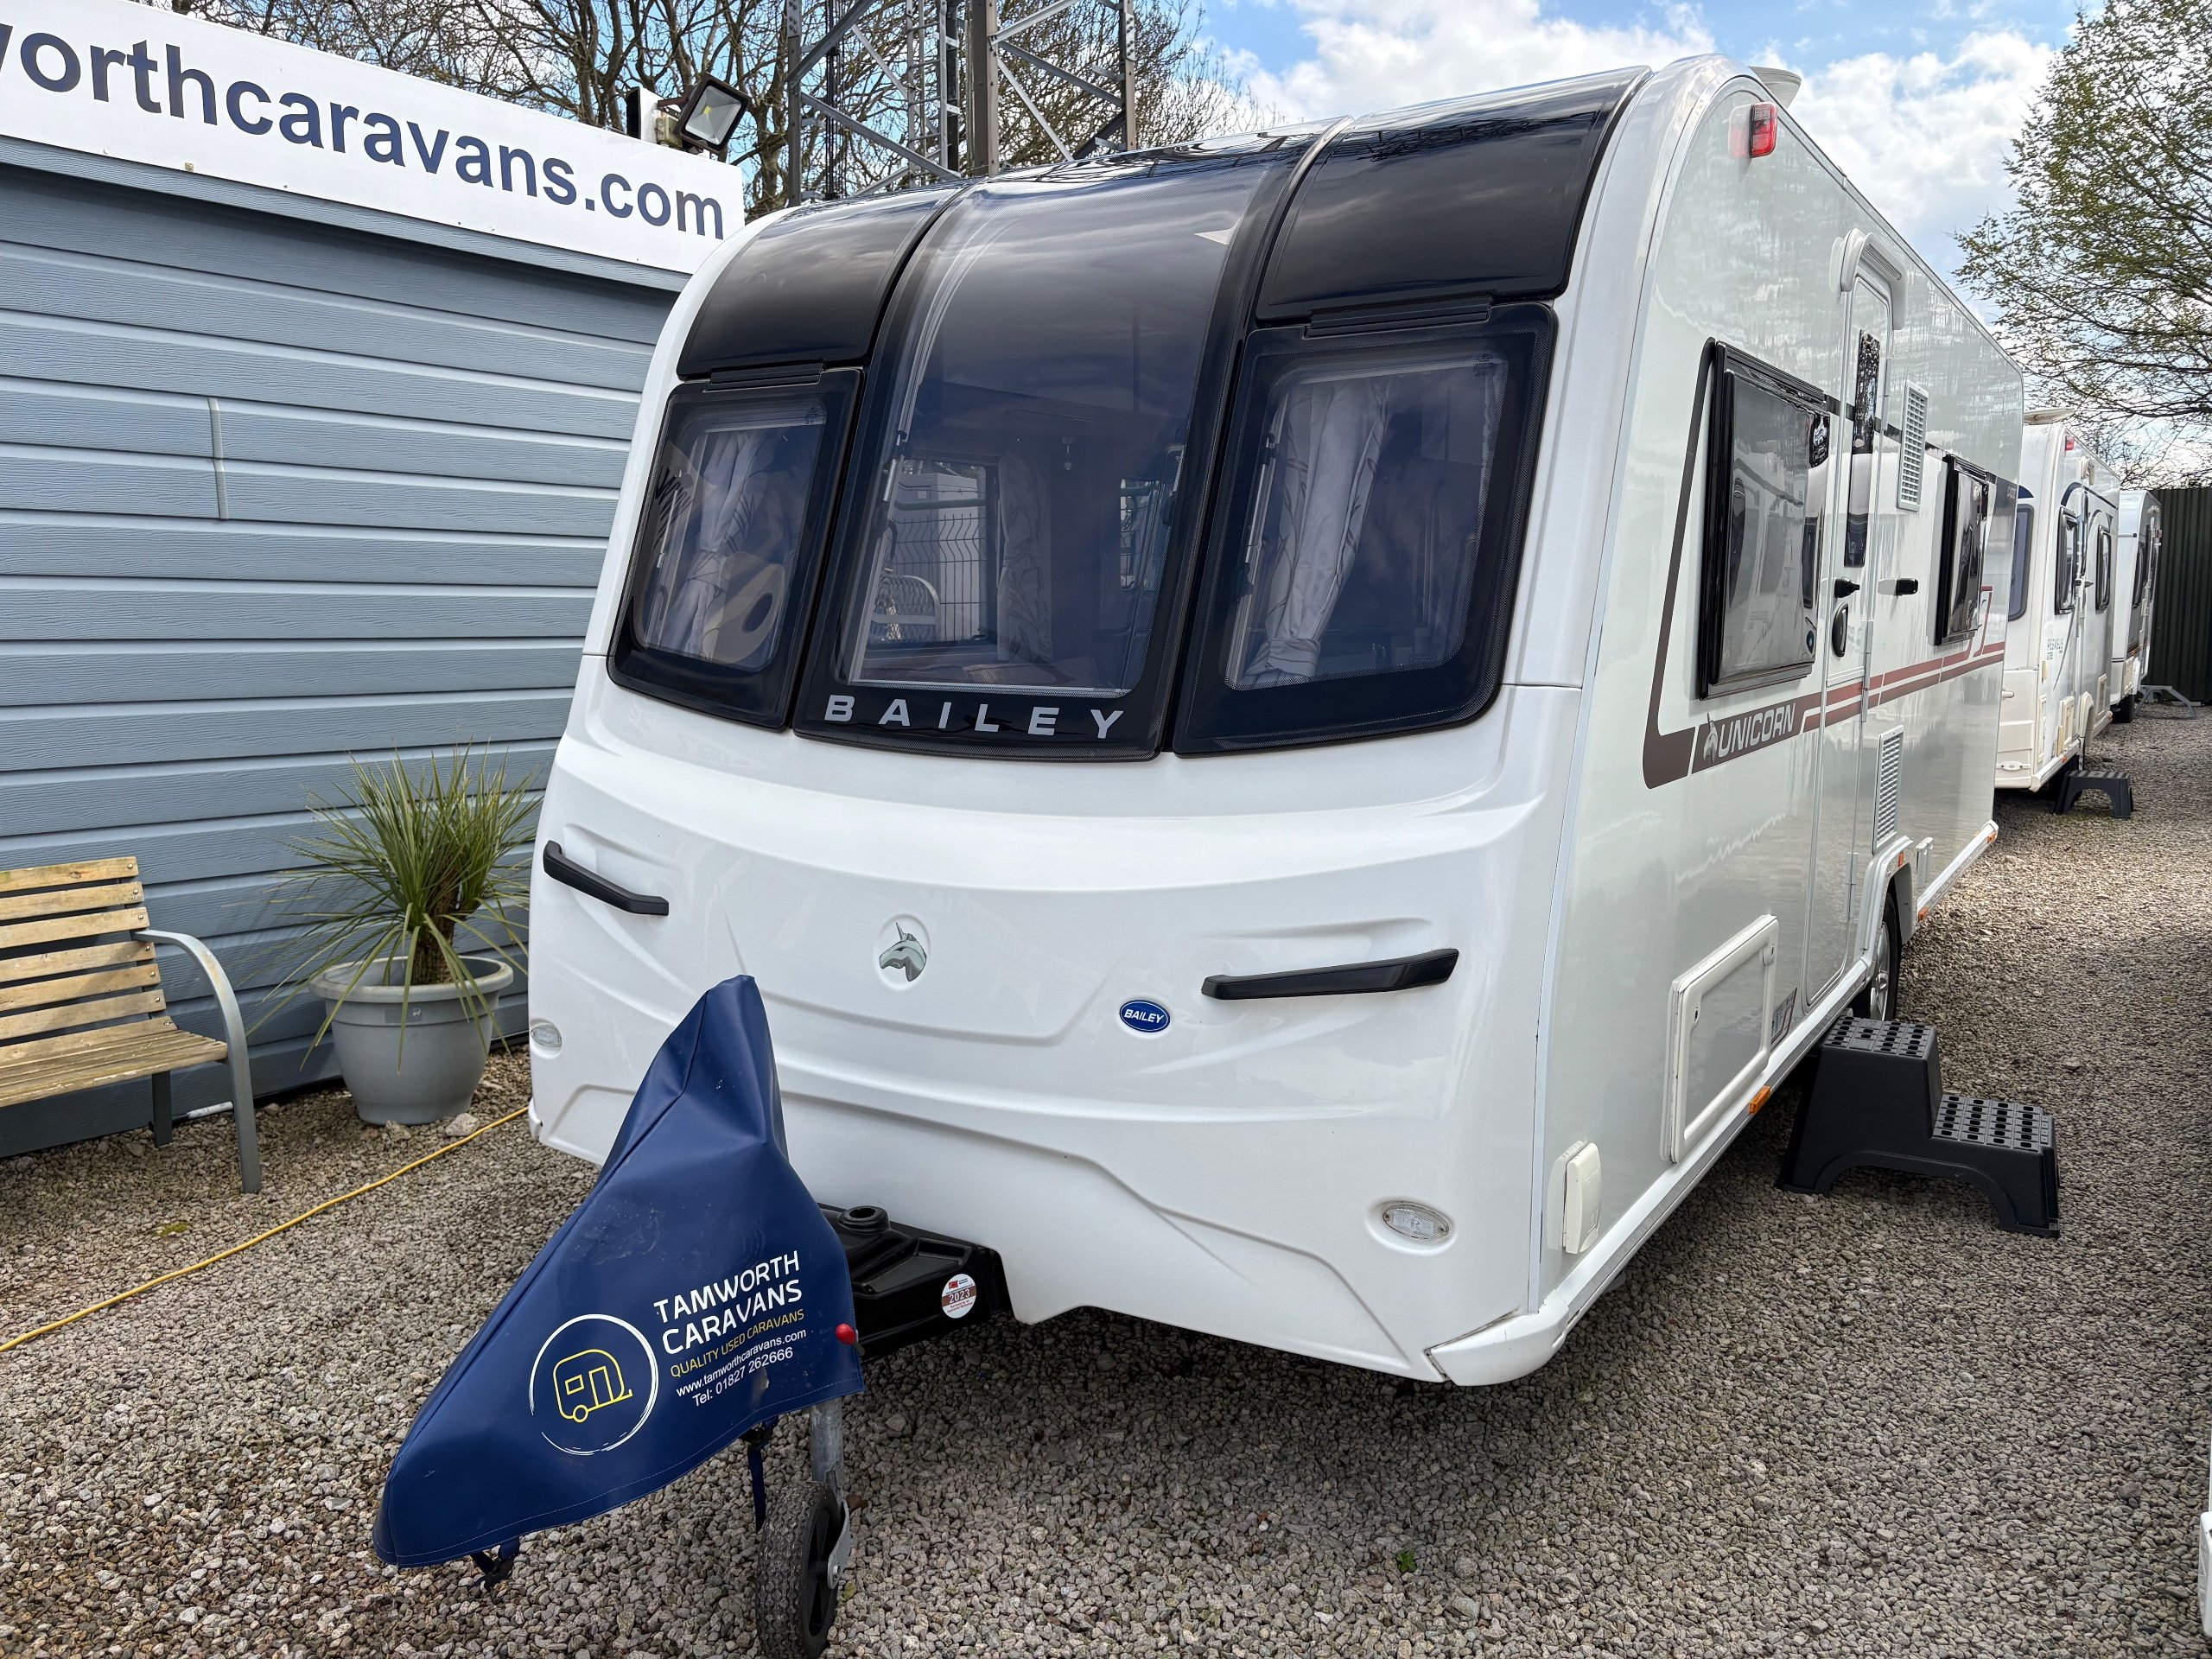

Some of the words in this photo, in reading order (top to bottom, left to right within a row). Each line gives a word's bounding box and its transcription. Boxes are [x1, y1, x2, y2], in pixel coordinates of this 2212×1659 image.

[0, 22, 724, 239] orthcaravans.com
[823, 694, 1124, 739] BAILEY
[1717, 702, 1796, 758] UNICORN
[1123, 1008, 1165, 1024] BAILEY
[653, 1250, 800, 1324] TAMWORTH
[662, 1279, 803, 1355] CARAVANS
[949, 1288, 970, 1304] 2023
[670, 1347, 719, 1378] QUALITY
[721, 1332, 746, 1356] USED
[747, 1308, 804, 1339] CARAVANS
[676, 1329, 807, 1397] www.tamworthcaravans.com
[691, 1389, 714, 1407] Tel:
[715, 1367, 746, 1395] 01827
[748, 1346, 794, 1374] 262666
